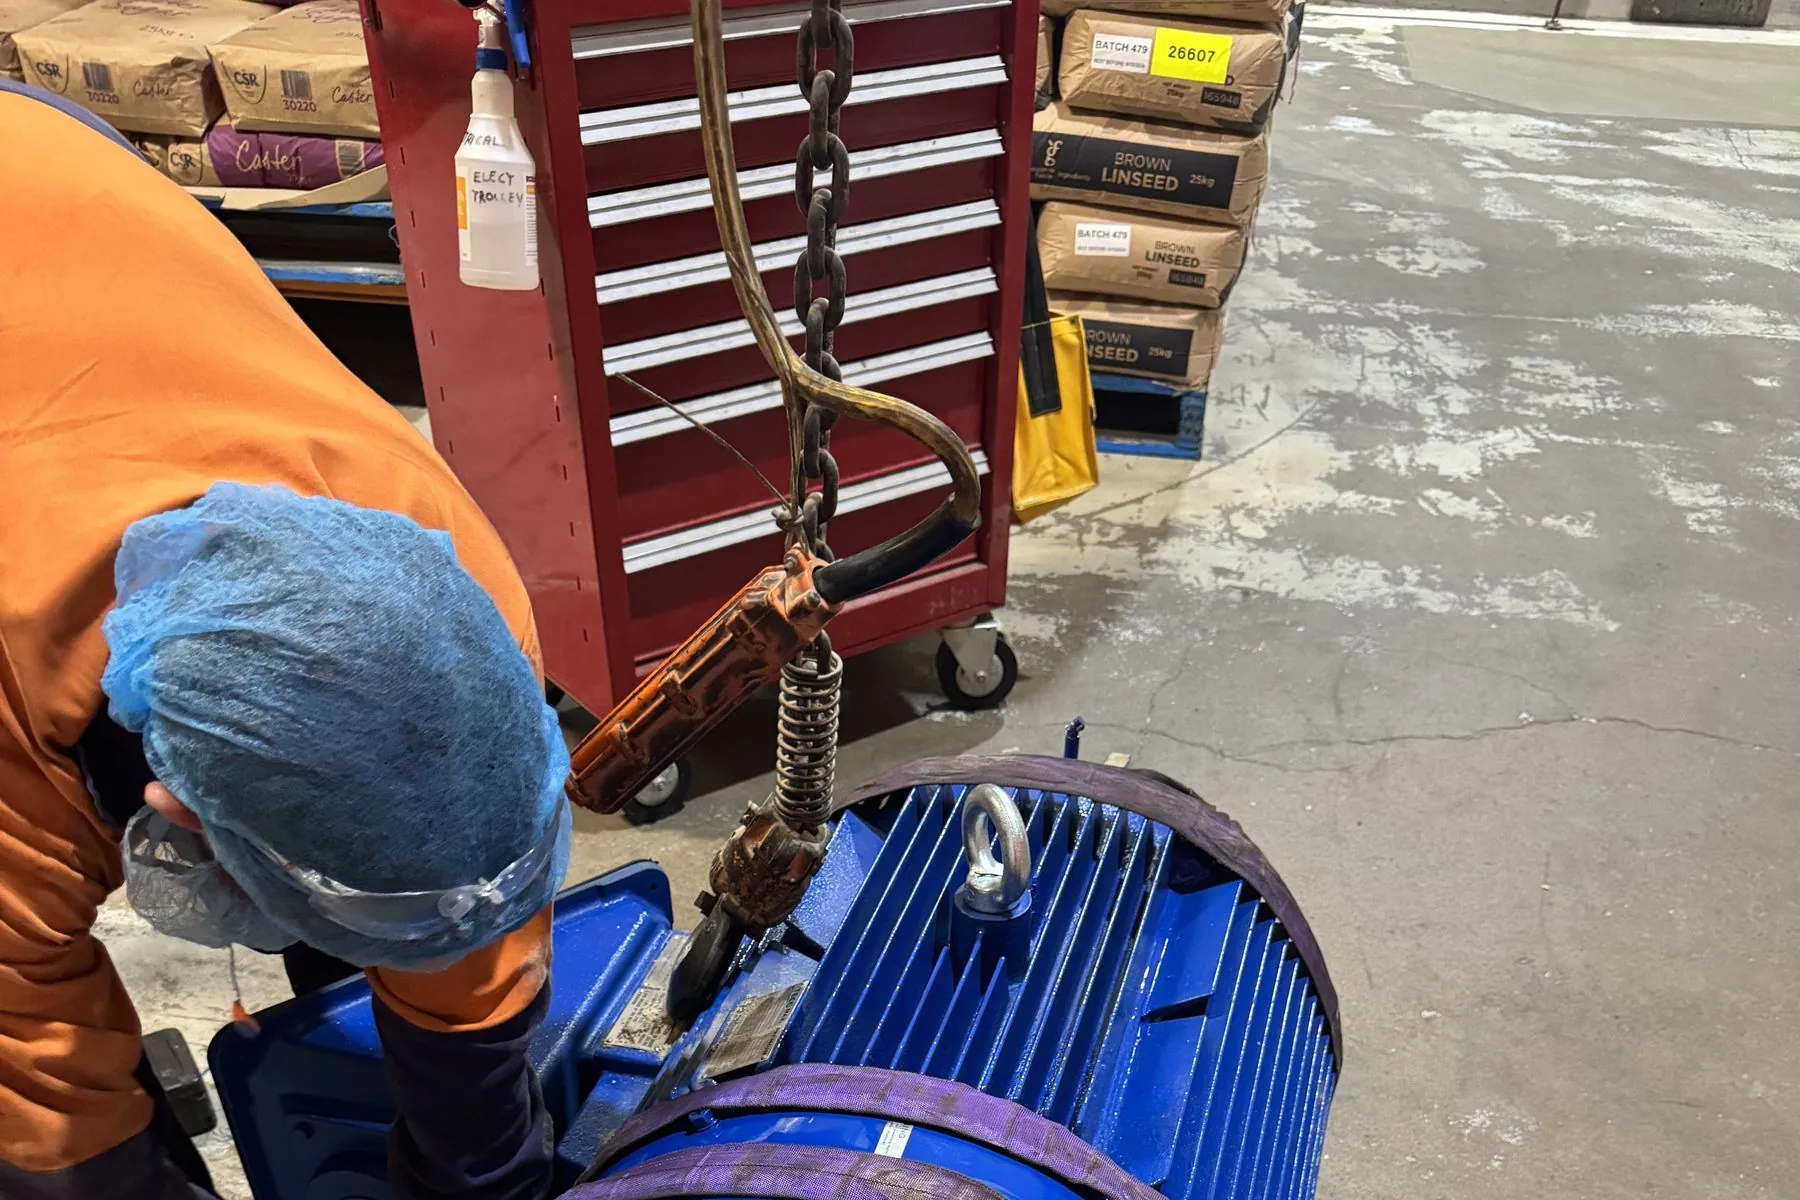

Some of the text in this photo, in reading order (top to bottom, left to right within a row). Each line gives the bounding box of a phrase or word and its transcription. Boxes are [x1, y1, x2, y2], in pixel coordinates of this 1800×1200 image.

[1094, 40, 1148, 54] BATCH 479
[1168, 45, 1216, 63] 26607
[36, 61, 62, 78] CSR
[233, 71, 260, 87] CSR
[133, 79, 173, 98] Caster
[332, 86, 372, 104] Caster
[86, 90, 120, 105] 30220
[282, 99, 317, 113] 30220
[236, 140, 302, 173] Caster
[1114, 151, 1172, 172] BROWN
[1101, 167, 1215, 191] LINSEED 25kg
[472, 189, 524, 206] TROLLEY
[1078, 229, 1127, 240] BATCH 479
[1154, 240, 1195, 254] BROWN
[1145, 250, 1200, 268] LINSEED
[1086, 329, 1132, 345] ROWN
